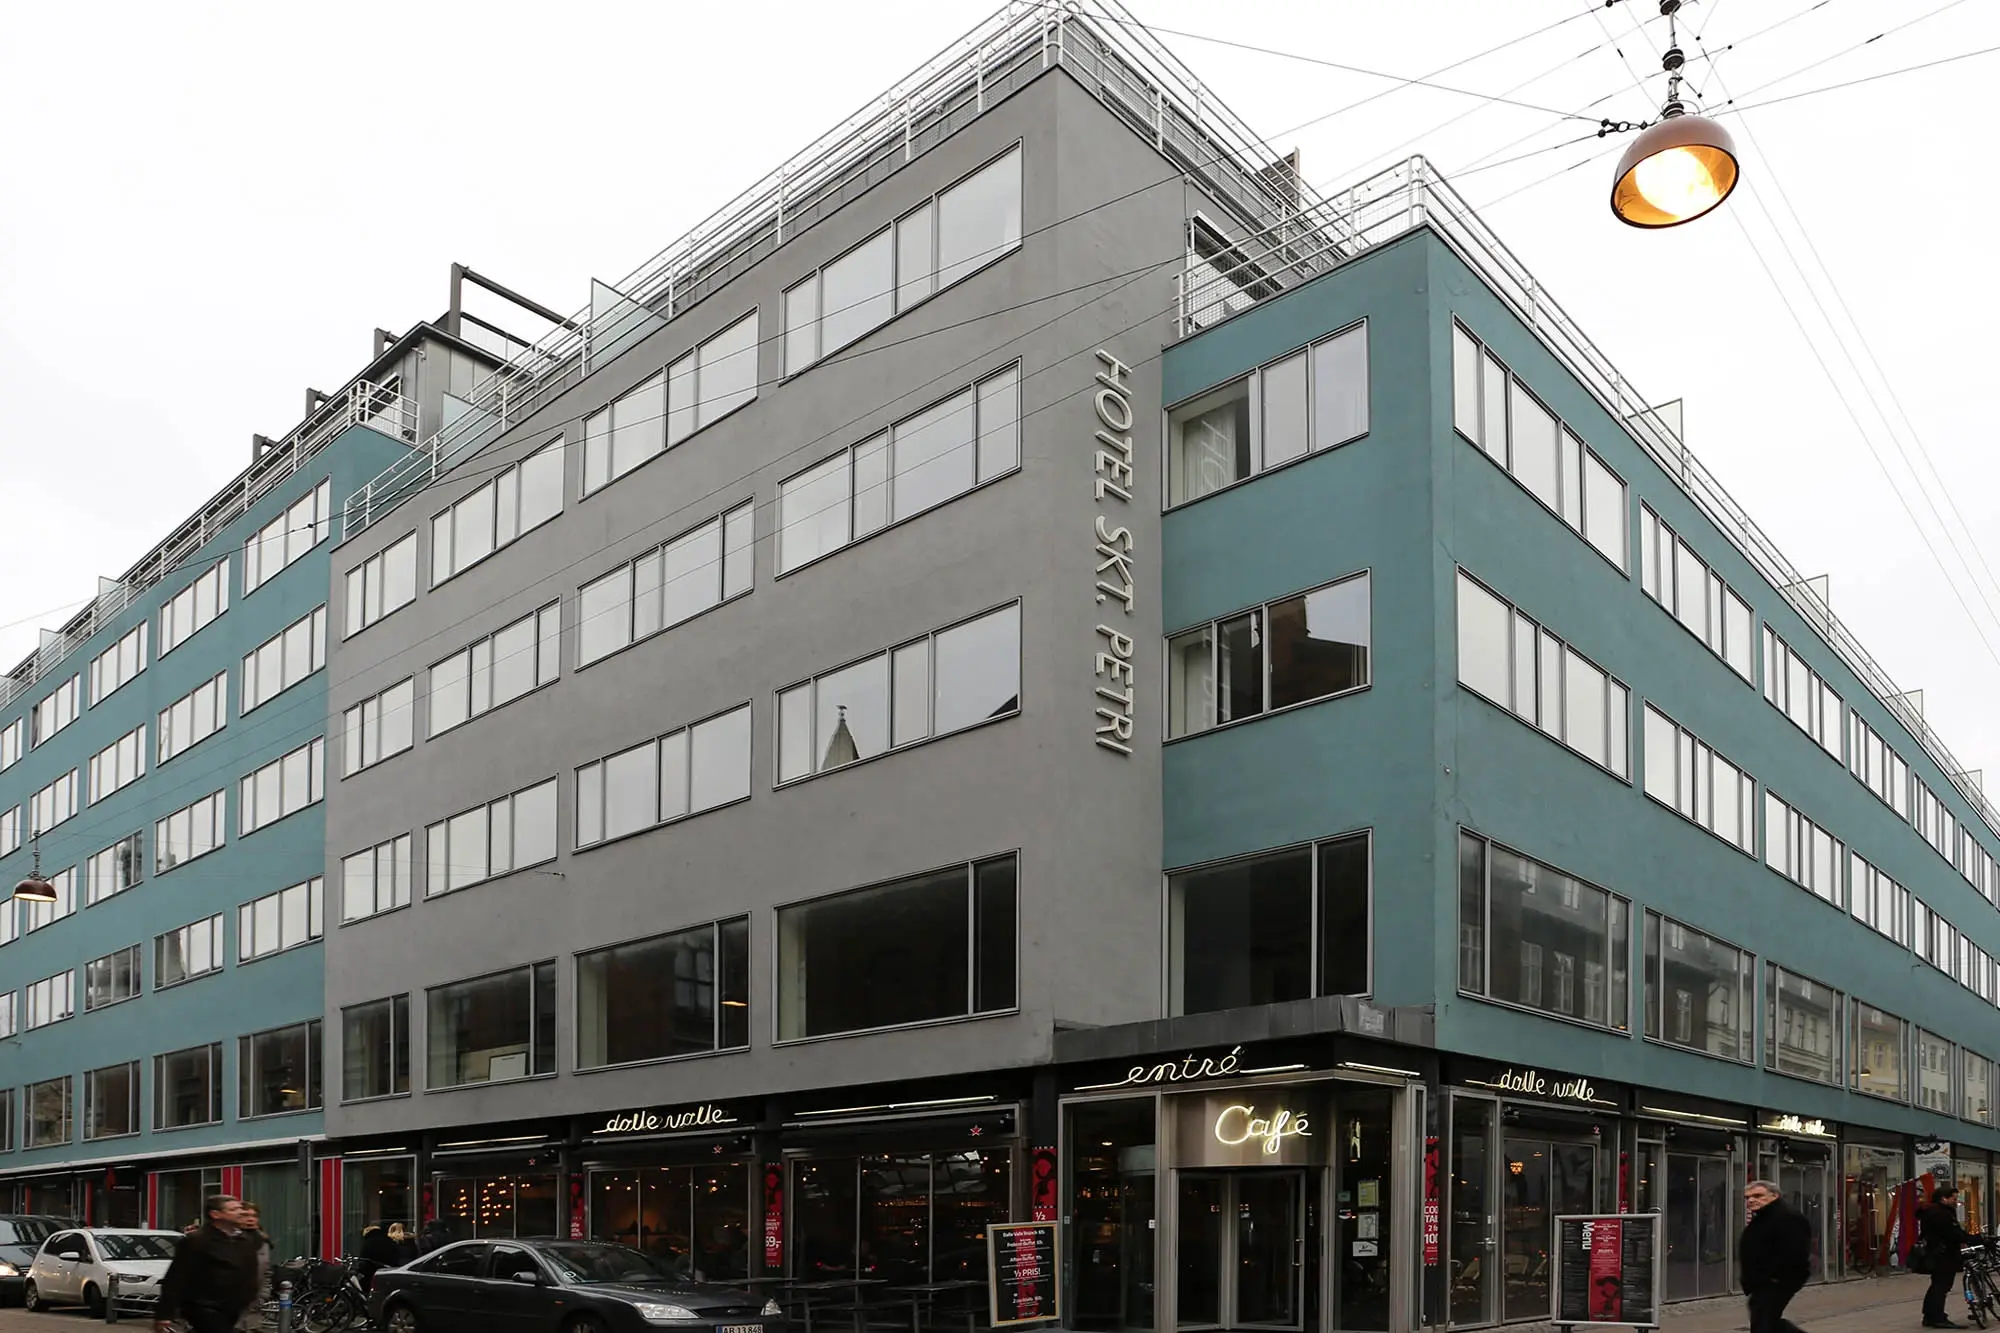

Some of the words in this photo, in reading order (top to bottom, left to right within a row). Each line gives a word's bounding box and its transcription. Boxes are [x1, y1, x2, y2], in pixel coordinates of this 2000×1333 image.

[1095, 348, 1133, 500] HOTEL
[1095, 515, 1134, 615] SKT.
[1095, 623, 1134, 756] PETRI
[1118, 1045, 1242, 1083] entré
[1498, 1068, 1545, 1095] dalle
[1551, 1078, 1599, 1103] valle
[604, 1110, 659, 1132] dalle
[664, 1103, 726, 1129] valle
[1214, 1104, 1312, 1154] Café
[1582, 1221, 1596, 1250] Menu
[1022, 1267, 1041, 1276] PRIS!
